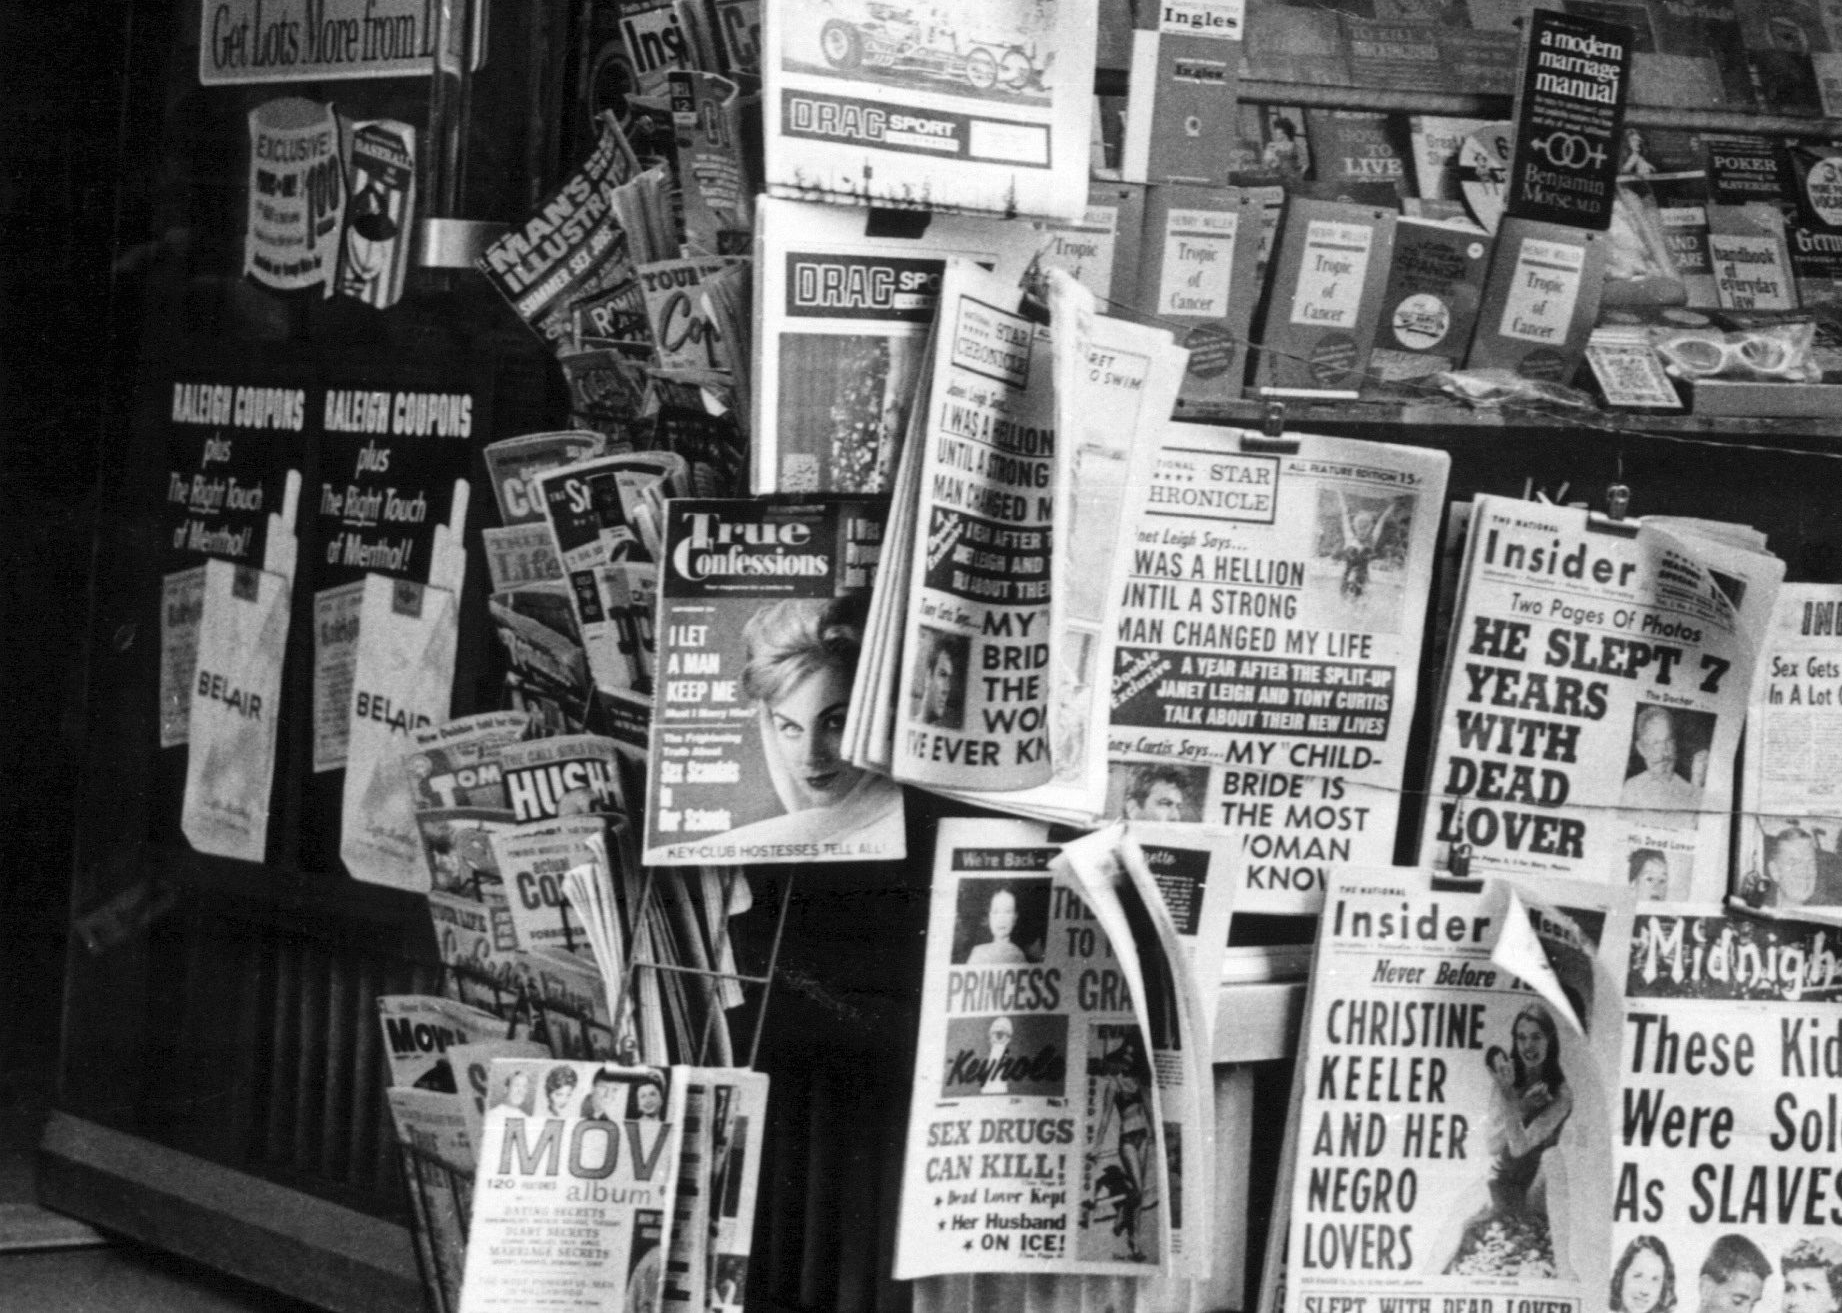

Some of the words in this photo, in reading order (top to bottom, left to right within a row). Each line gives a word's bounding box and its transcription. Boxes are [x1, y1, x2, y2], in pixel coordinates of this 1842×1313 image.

[212, 2, 250, 71] Get
[1161, 6, 1241, 31] Ingles
[1538, 50, 1622, 85] marriage
[1539, 31, 1554, 47] a
[1555, 31, 1623, 61] modern
[1534, 71, 1619, 106] manual
[790, 96, 887, 141] DRAG
[888, 113, 956, 137] SPORT
[1713, 155, 1779, 173] POKER
[795, 262, 895, 309] DRAG
[172, 382, 232, 425] RALEIGH
[234, 386, 305, 430] COUPONS
[324, 389, 391, 434] RALEIGH
[393, 391, 473, 438] COUPONS
[203, 433, 231, 469] plus
[354, 440, 391, 479] plus
[1209, 464, 1271, 485] STAR
[682, 512, 811, 550] True
[673, 535, 829, 582] Confessions
[1134, 549, 1185, 579] WAS
[1191, 553, 1207, 580] A
[1214, 557, 1305, 587] HELLION
[1483, 528, 1636, 588] Insider
[1173, 620, 1276, 653] CHANGED
[1285, 630, 1321, 656] MY
[1327, 632, 1374, 659] LIFE
[1469, 616, 1531, 662] HE
[1544, 627, 1682, 685] SLEPT
[1699, 653, 1730, 693] 7
[197, 670, 262, 721] BELAIR
[666, 681, 706, 703] KEEP
[712, 680, 738, 703] ME
[1466, 663, 1609, 720] YEARS
[1768, 687, 1783, 706] In
[1789, 686, 1801, 705] A
[1807, 685, 1832, 706] Lot
[1456, 709, 1581, 764] WITH
[1444, 755, 1570, 809] DEAD
[1221, 802, 1273, 828] THE
[1285, 805, 1370, 833] MOST
[1436, 801, 1586, 859] LOVER
[1332, 900, 1492, 943] Insider
[946, 967, 1061, 1013] PRINCESS
[1372, 958, 1426, 984] Never
[1434, 961, 1496, 988] Before
[1326, 998, 1486, 1050] CHRISTINE
[1627, 1012, 1755, 1076] These
[1317, 1054, 1447, 1104] KEELER
[926, 1122, 971, 1148] SEX
[977, 1117, 1075, 1145] DRUGS
[1312, 1110, 1386, 1158] AND
[1403, 1112, 1468, 1160] HER
[1623, 1088, 1734, 1149] Were
[566, 1183, 652, 1206] album
[1307, 1167, 1417, 1214] NEGRO
[1613, 1162, 1665, 1223] As
[951, 1215, 979, 1231] Her
[984, 1212, 1066, 1231] Husband
[980, 1234, 1009, 1252] ON
[1020, 1233, 1066, 1252] ICE!
[1302, 1222, 1413, 1271] LOVERS
